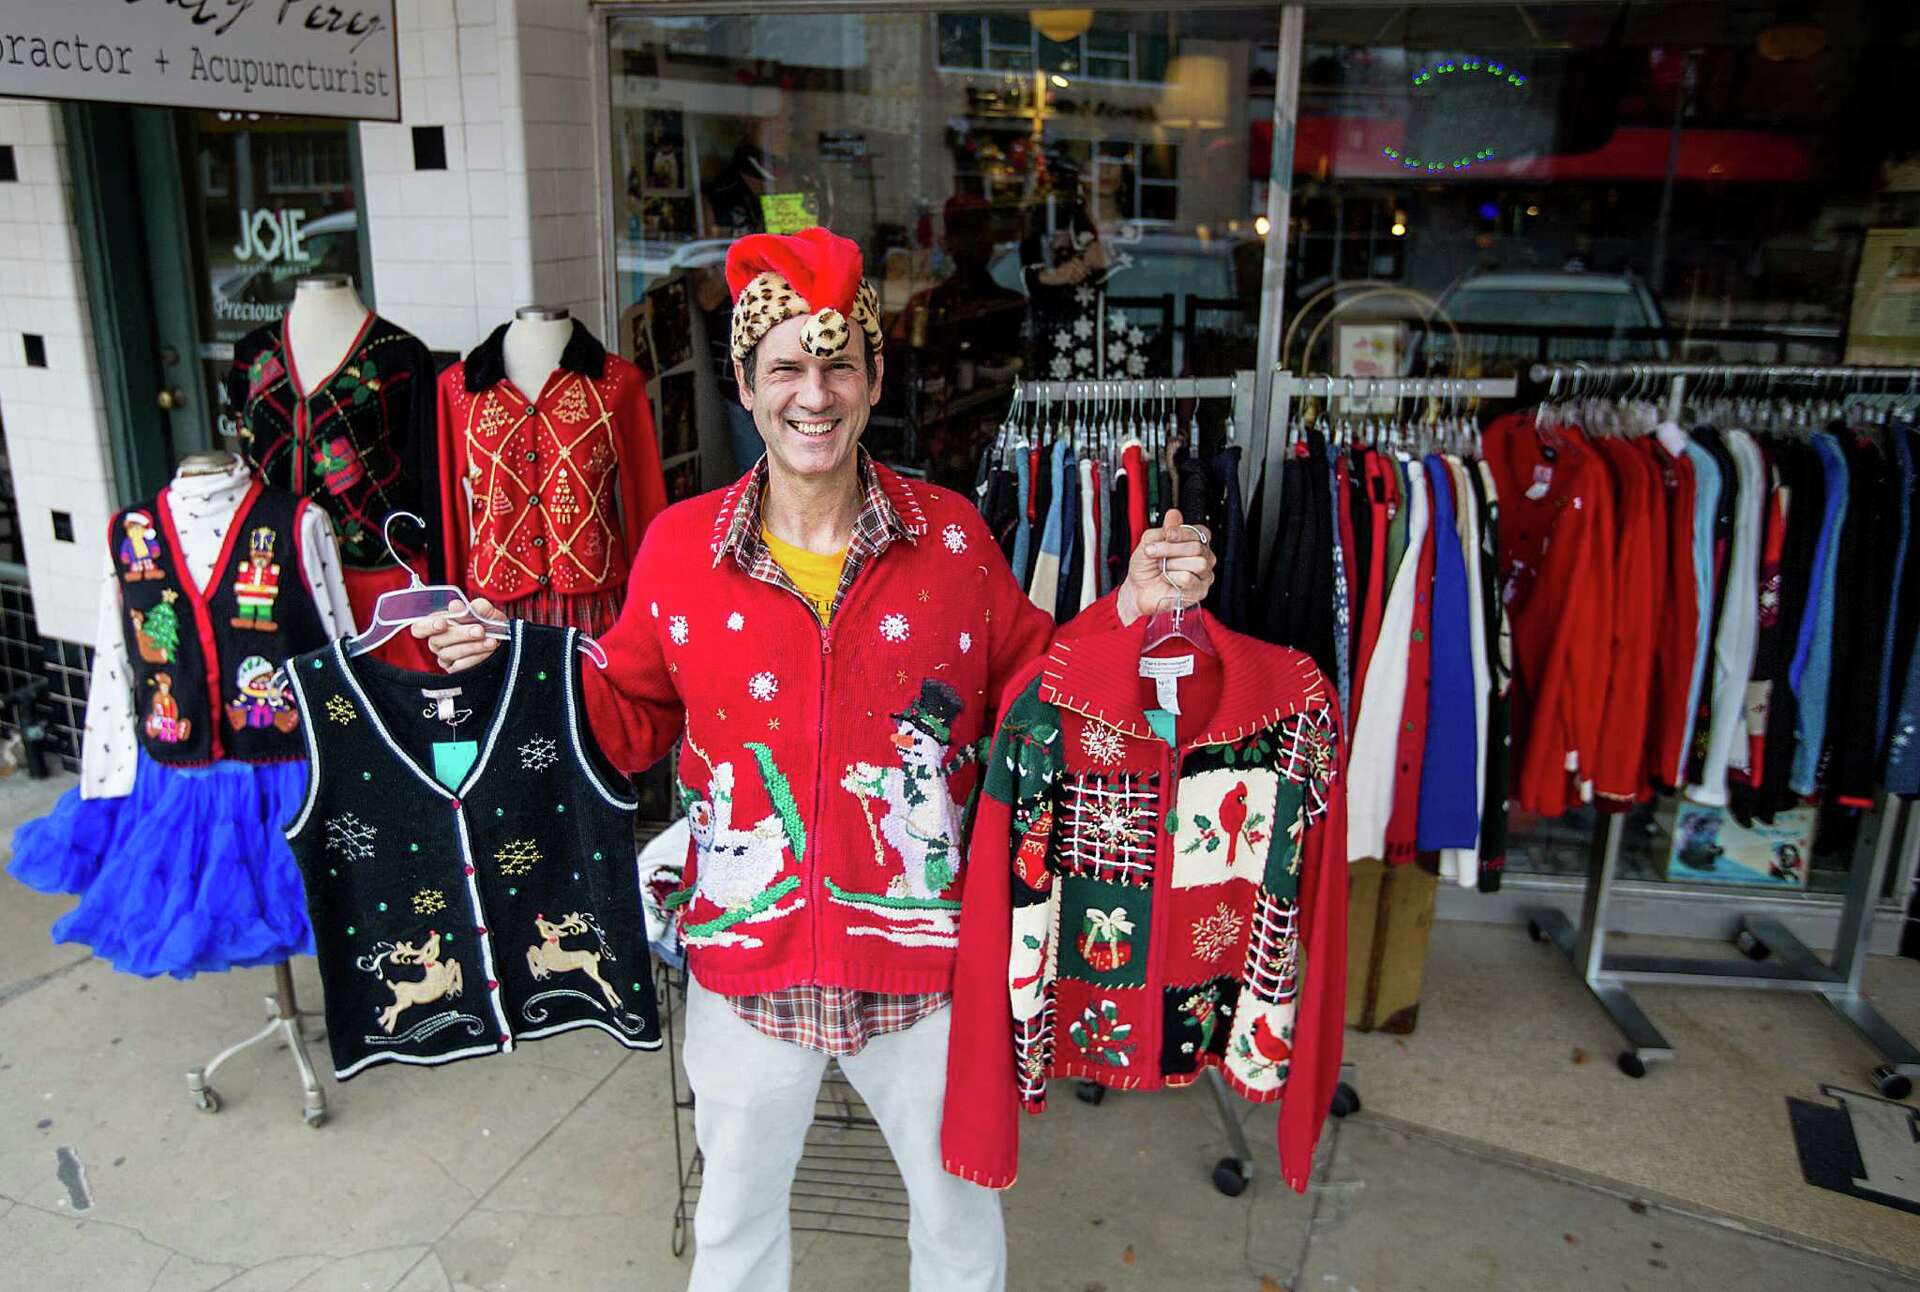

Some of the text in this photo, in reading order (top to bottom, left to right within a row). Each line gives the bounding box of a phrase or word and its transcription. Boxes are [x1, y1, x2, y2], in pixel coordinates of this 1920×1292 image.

[0, 33, 133, 74] ractor
[190, 45, 389, 96] Acupuncturist
[233, 208, 310, 261] JOIE
